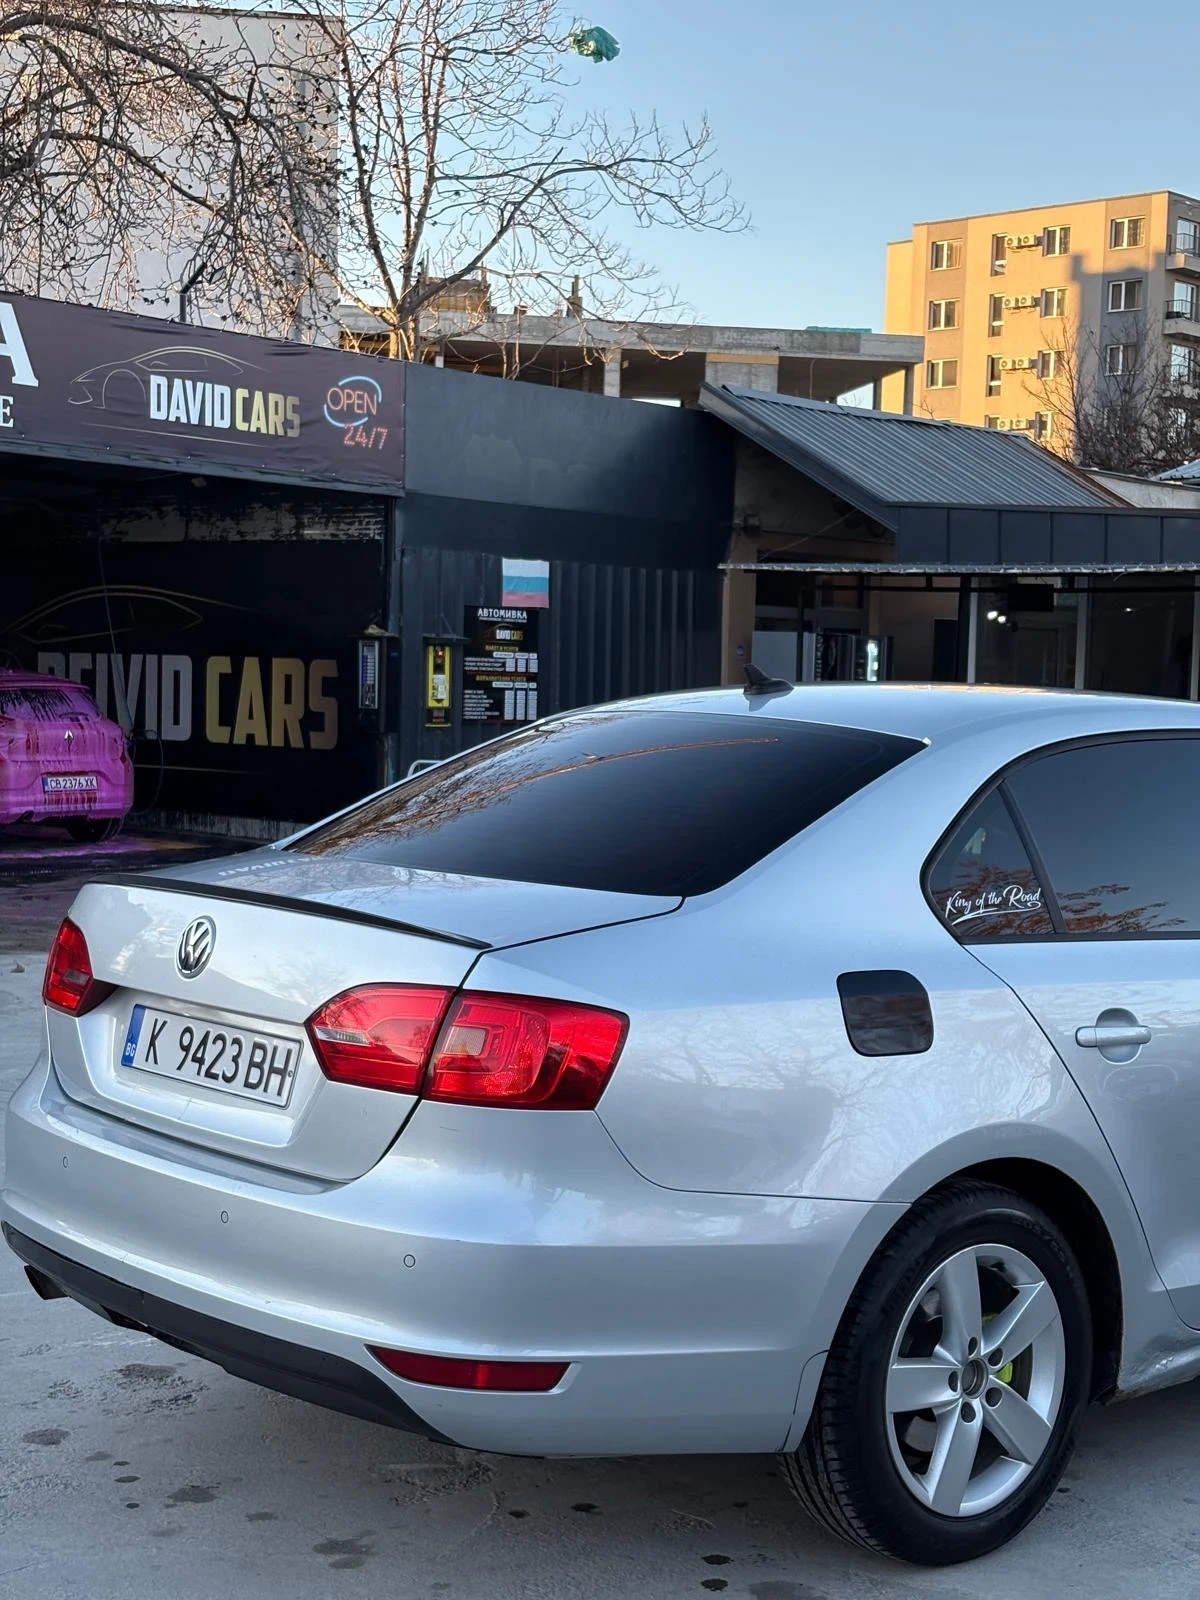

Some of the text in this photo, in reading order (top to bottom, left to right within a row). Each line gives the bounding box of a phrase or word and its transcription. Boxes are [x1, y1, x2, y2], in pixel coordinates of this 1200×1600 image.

[149, 374, 301, 437] DAVID CARS
[327, 387, 377, 415] OPEN
[344, 423, 388, 450] 24/7
[477, 608, 528, 620] АВТОМИВКА
[205, 655, 339, 751] CARS
[945, 884, 1042, 919] King of the Road
[125, 1042, 137, 1058] BG
[145, 1018, 168, 1065] K
